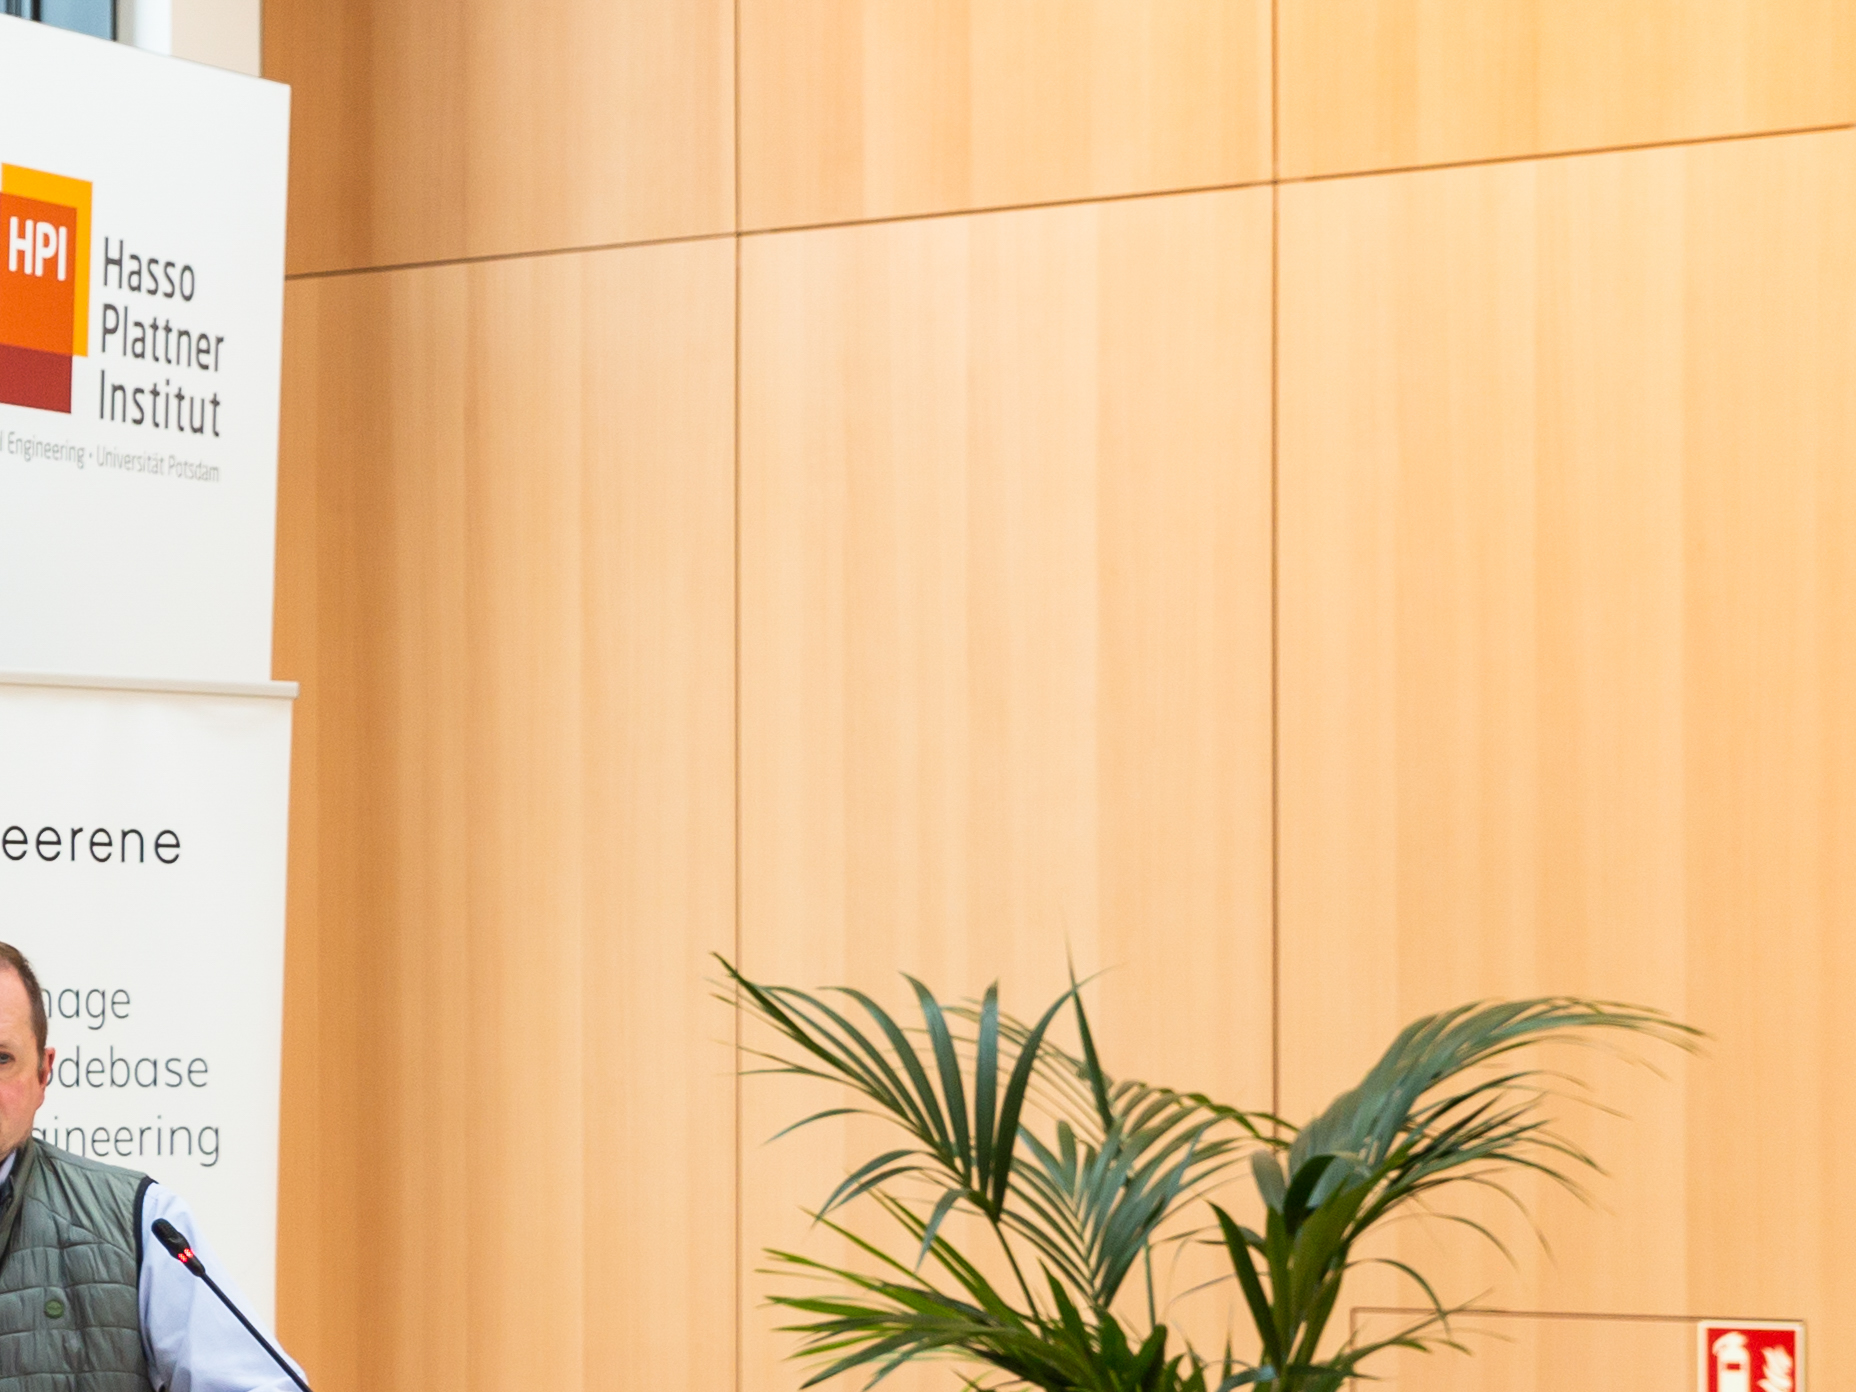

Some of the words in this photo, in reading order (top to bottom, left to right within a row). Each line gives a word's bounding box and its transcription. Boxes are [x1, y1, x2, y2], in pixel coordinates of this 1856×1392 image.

[7, 216, 68, 282] HPI
[103, 236, 196, 302] Hasso
[102, 303, 225, 373] Plattner
[99, 368, 221, 437] Institut
[7, 431, 85, 469] Engineering
[96, 445, 164, 475] Universität
[168, 454, 220, 483] Potsdam
